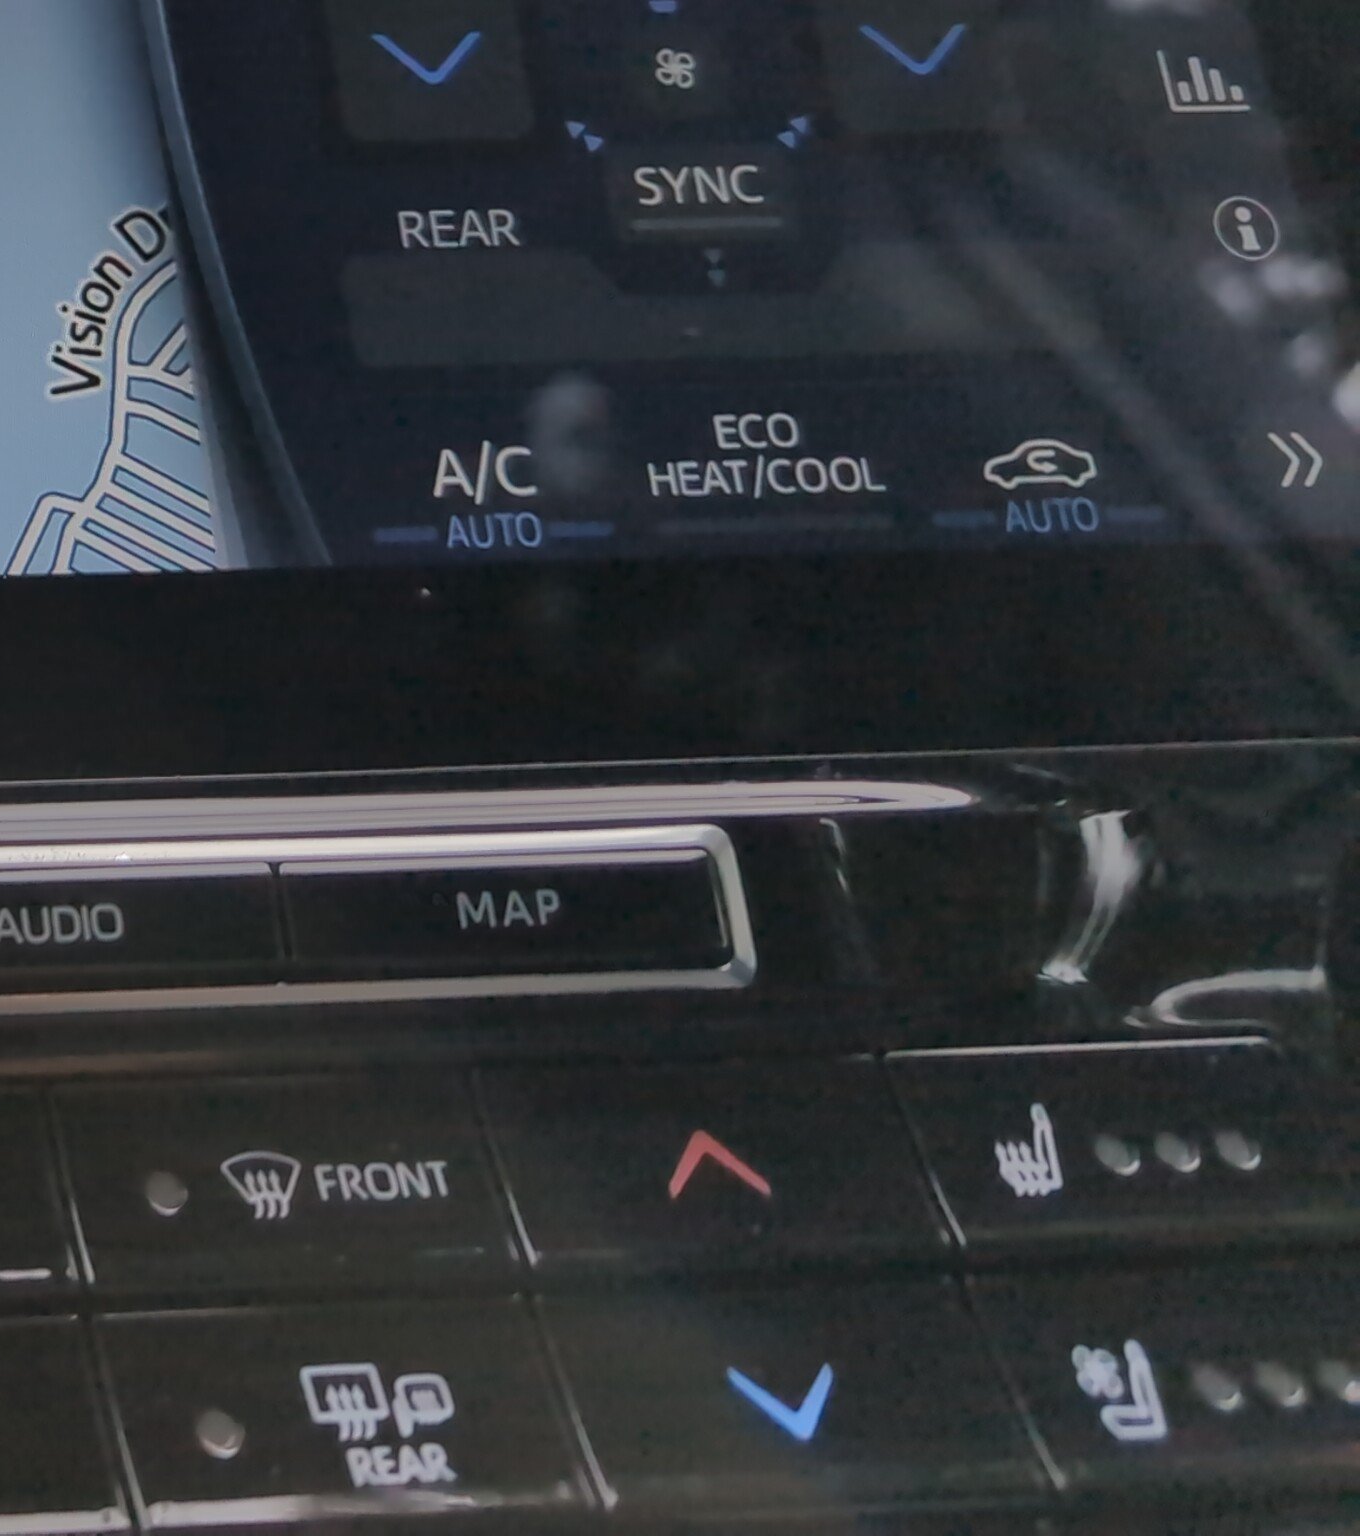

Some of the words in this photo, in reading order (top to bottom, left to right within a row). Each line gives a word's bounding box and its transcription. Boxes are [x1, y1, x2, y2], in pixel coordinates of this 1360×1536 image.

[633, 164, 765, 206] SYNC
[397, 208, 522, 249] REAR
[49, 254, 133, 395] Vision
[713, 412, 800, 450] ECO
[432, 440, 538, 505] A/C
[646, 454, 887, 499] HEAT/COOL
[445, 511, 544, 549] AUTO
[1004, 495, 1101, 534] AUTO
[455, 887, 561, 931] MAP
[313, 1159, 450, 1204] FRONT
[344, 1442, 458, 1489] REAR
